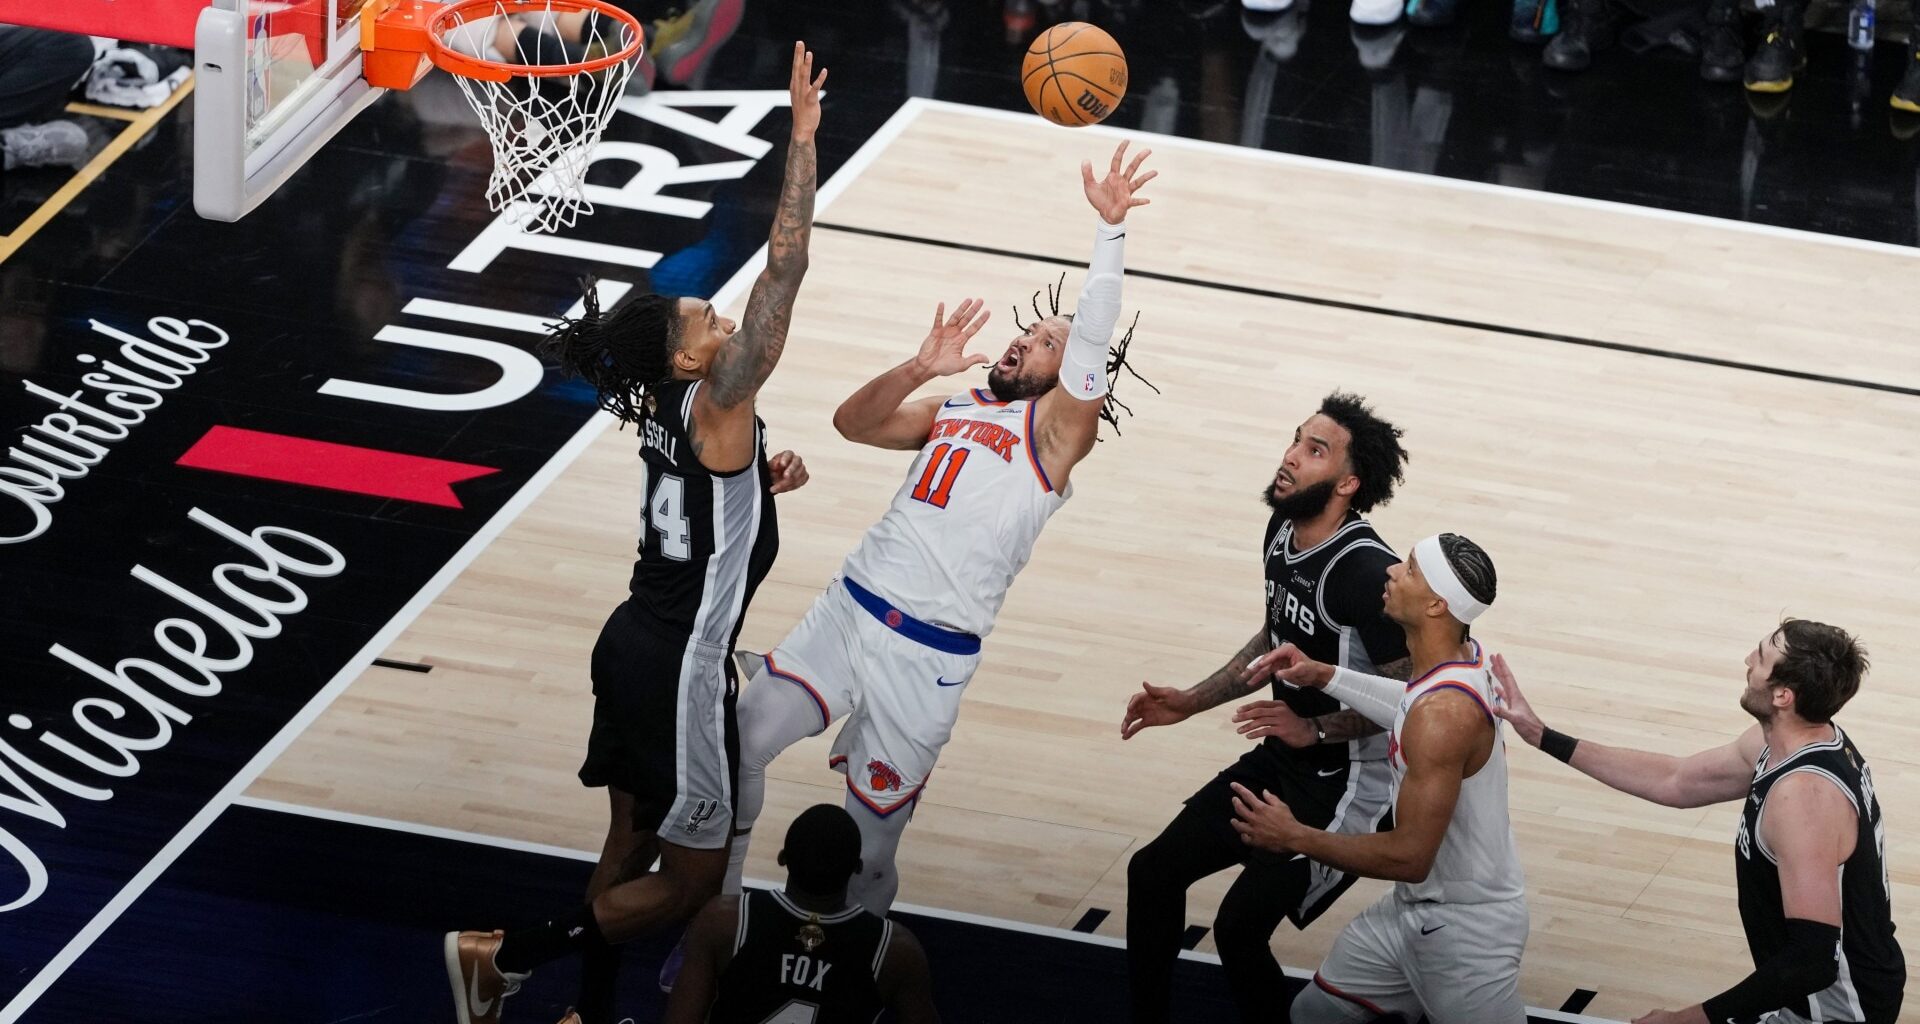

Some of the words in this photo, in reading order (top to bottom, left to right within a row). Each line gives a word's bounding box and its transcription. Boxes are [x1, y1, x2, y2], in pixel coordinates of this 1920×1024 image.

[317, 90, 827, 412] ULTRA
[640, 418, 678, 467] ASSELL
[961, 419, 1021, 463] YORK
[910, 442, 971, 509] 11
[780, 953, 832, 991] FOX
